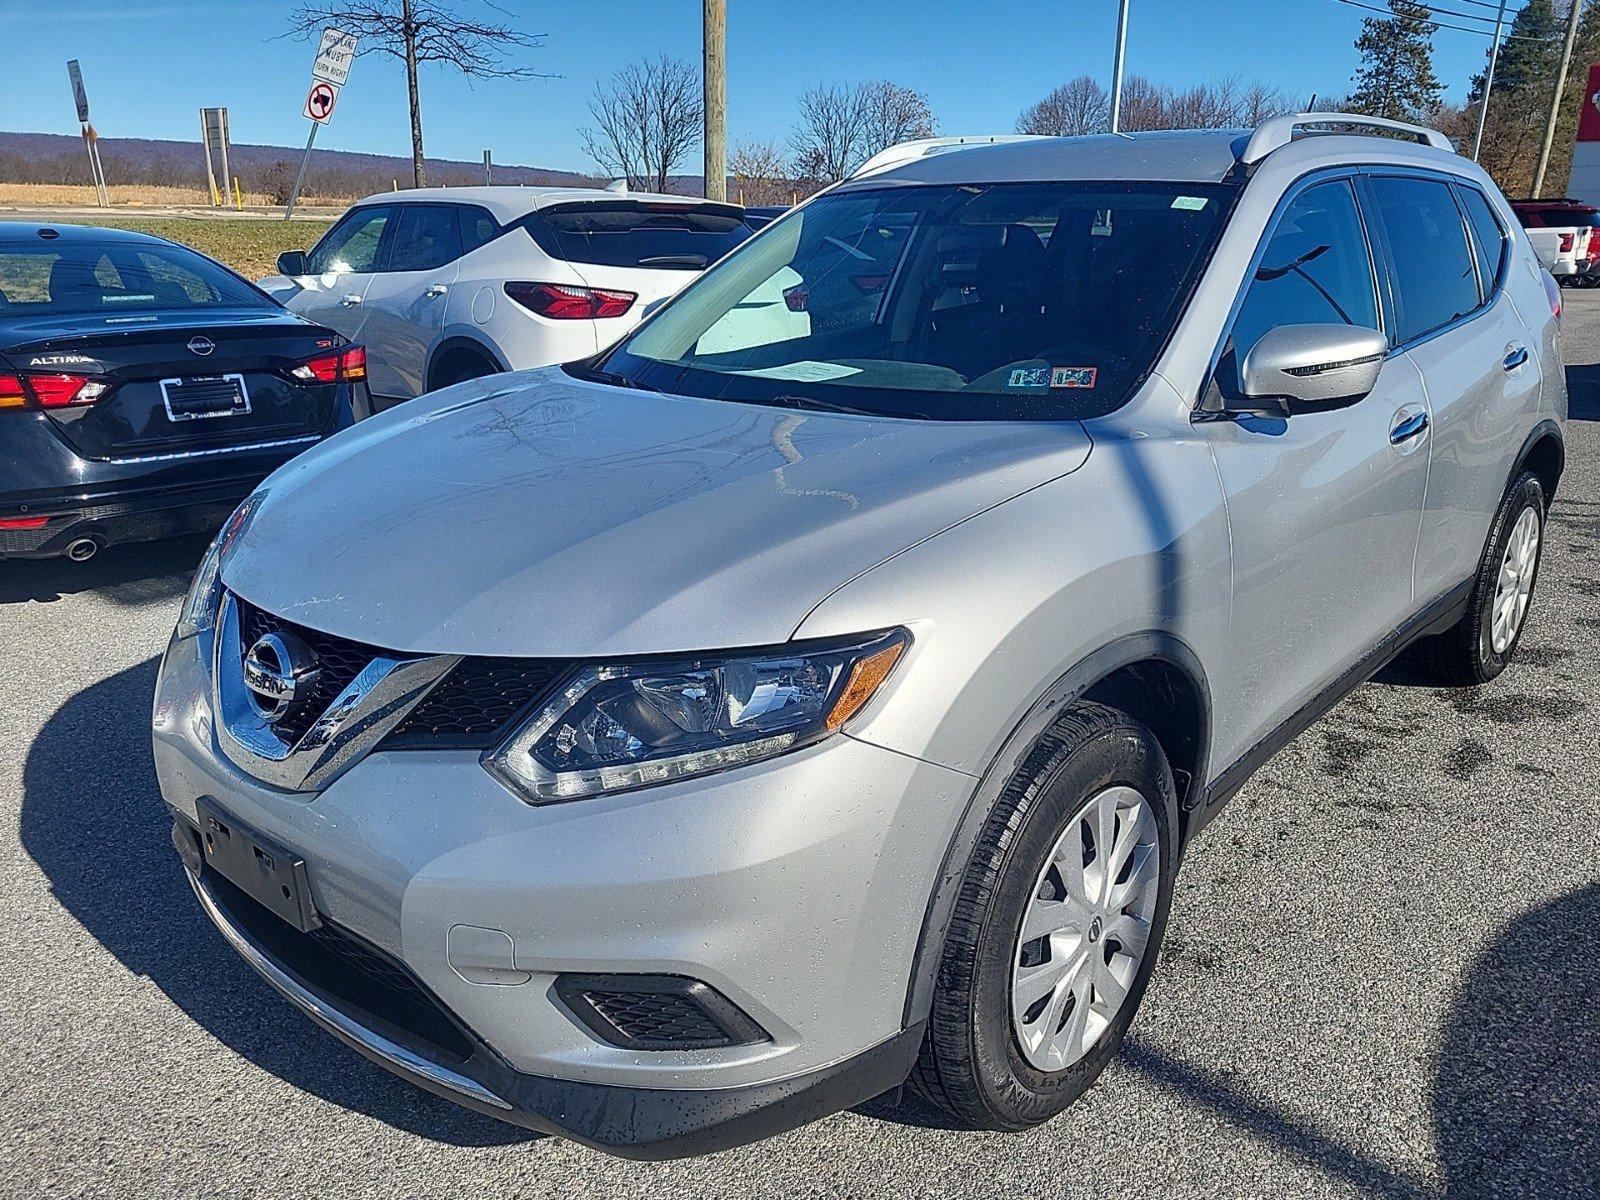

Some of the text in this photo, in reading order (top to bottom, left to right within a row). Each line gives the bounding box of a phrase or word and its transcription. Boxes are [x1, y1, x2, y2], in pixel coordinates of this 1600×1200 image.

[325, 50, 344, 62] MUST
[316, 61, 346, 78] TURN RIGHT
[30, 355, 94, 366] ALTIMA
